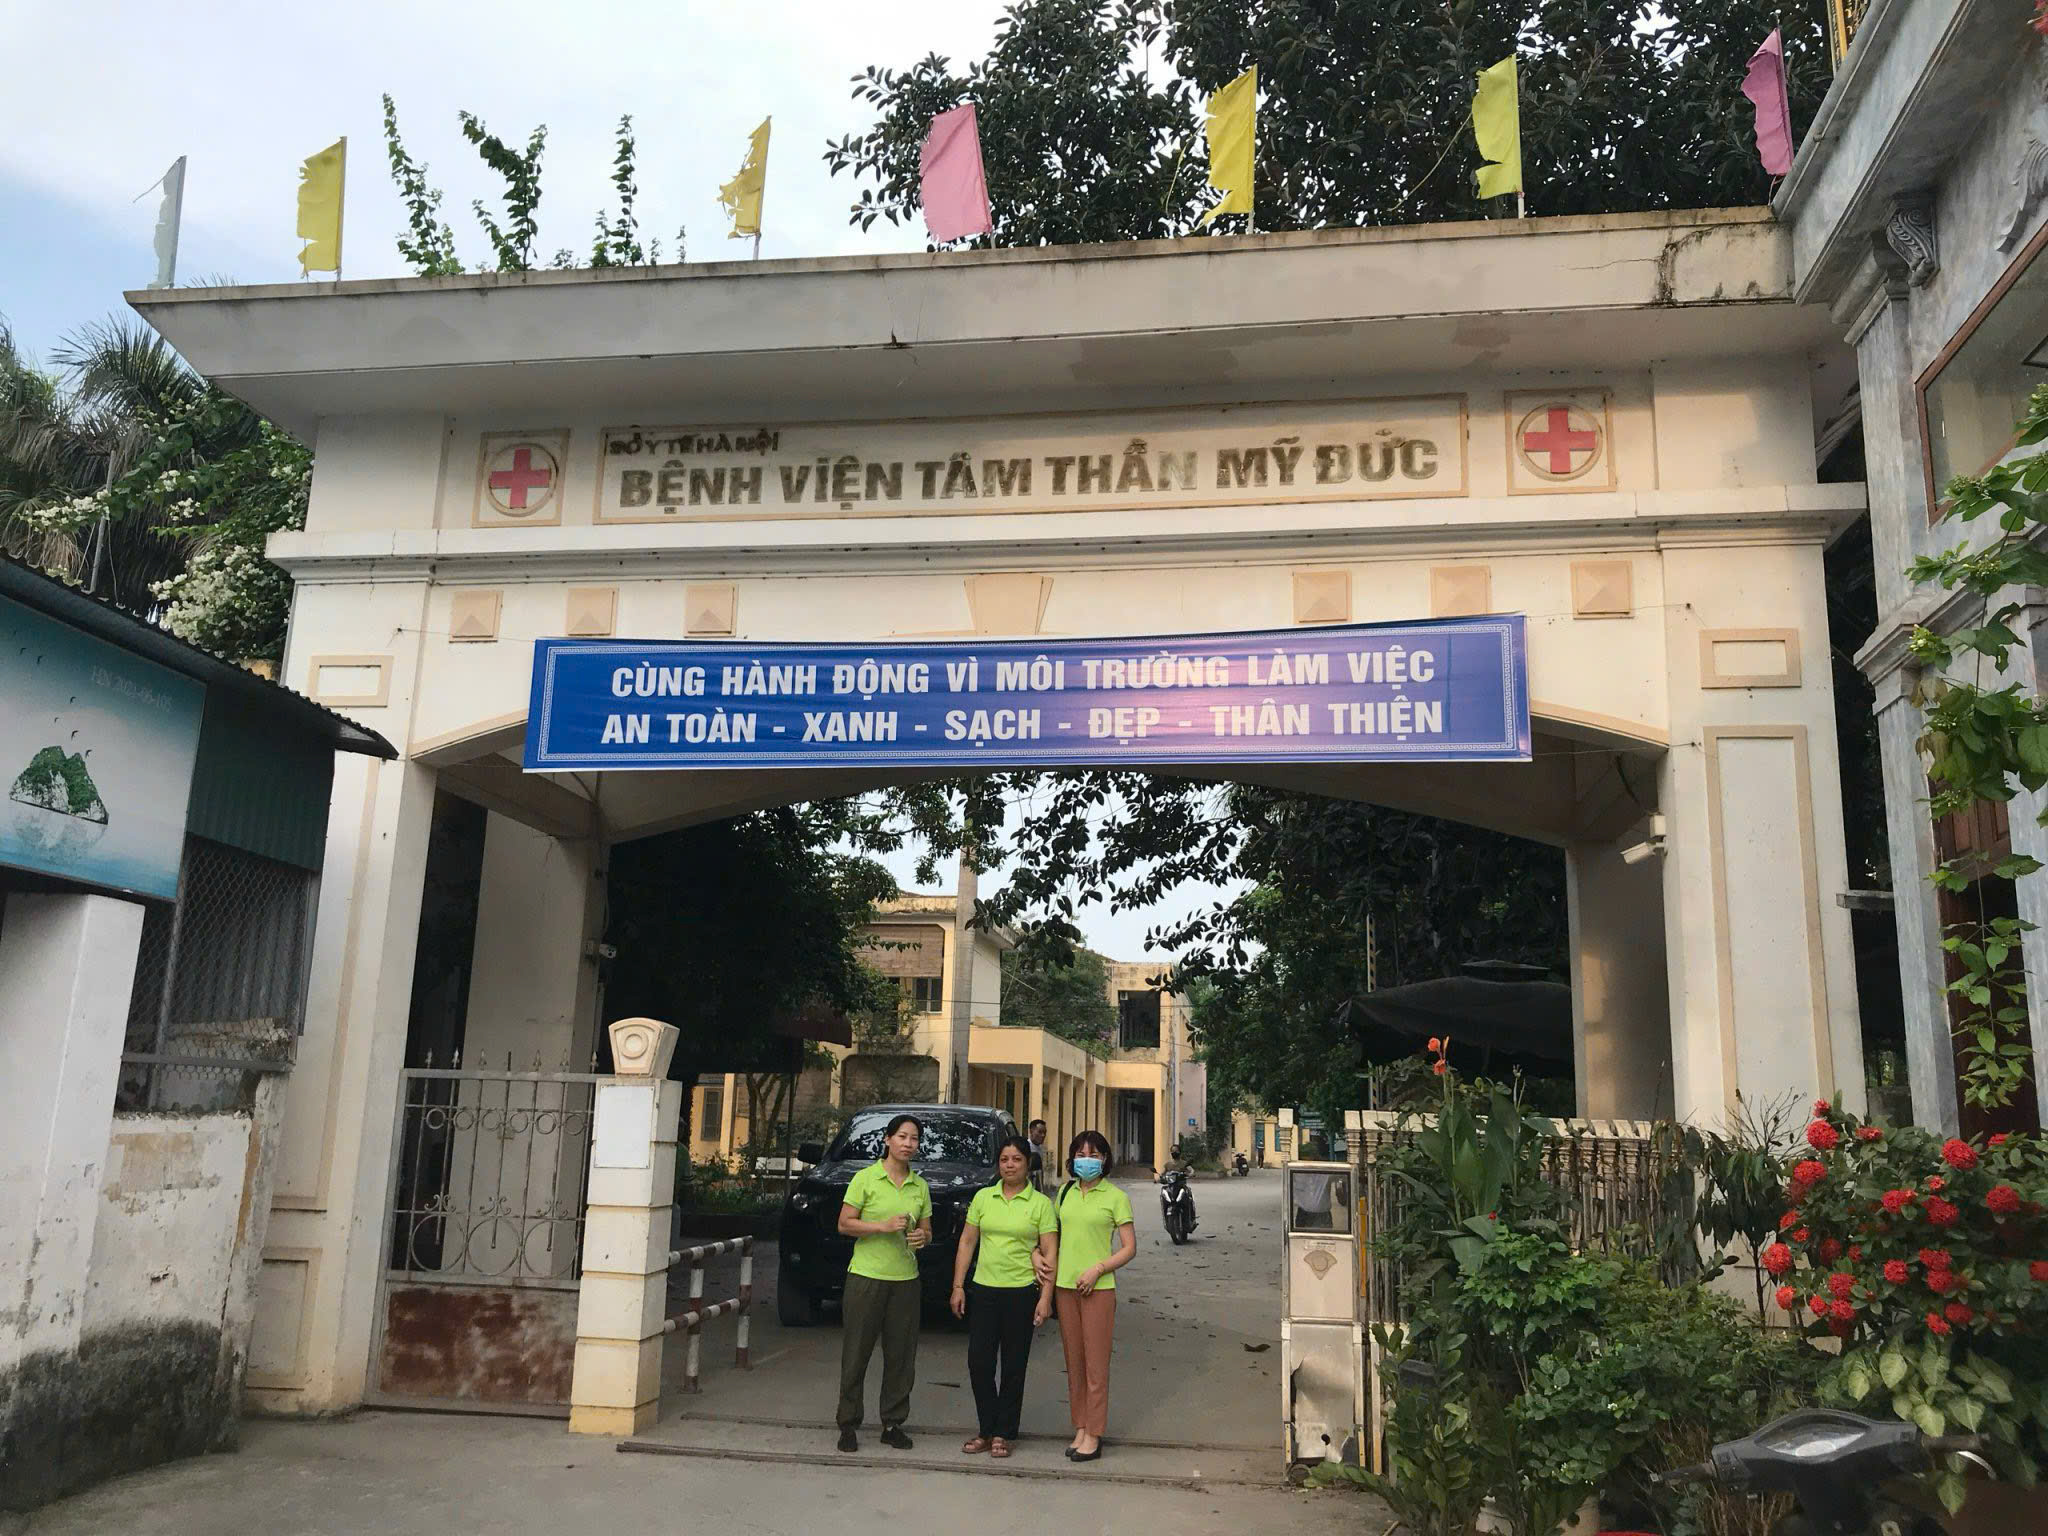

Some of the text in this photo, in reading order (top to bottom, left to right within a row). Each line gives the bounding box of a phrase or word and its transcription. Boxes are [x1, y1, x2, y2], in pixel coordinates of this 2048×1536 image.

[619, 428, 1438, 514] BỆNH VIỆN TÂM THẦN MỸ ĐỨC
[611, 644, 1435, 701] CÙNG HÀNH ĐỘNG VÌ MÔI TRƯỜNG LÀM VIỆC
[600, 713, 650, 744] AN
[666, 706, 757, 744] TOÀN
[802, 711, 898, 743] XANH
[945, 708, 1041, 747] SẠCH
[1088, 706, 1161, 745] ĐẸP
[1209, 697, 1311, 737] THÂN
[1328, 695, 1443, 741] THIỆN
